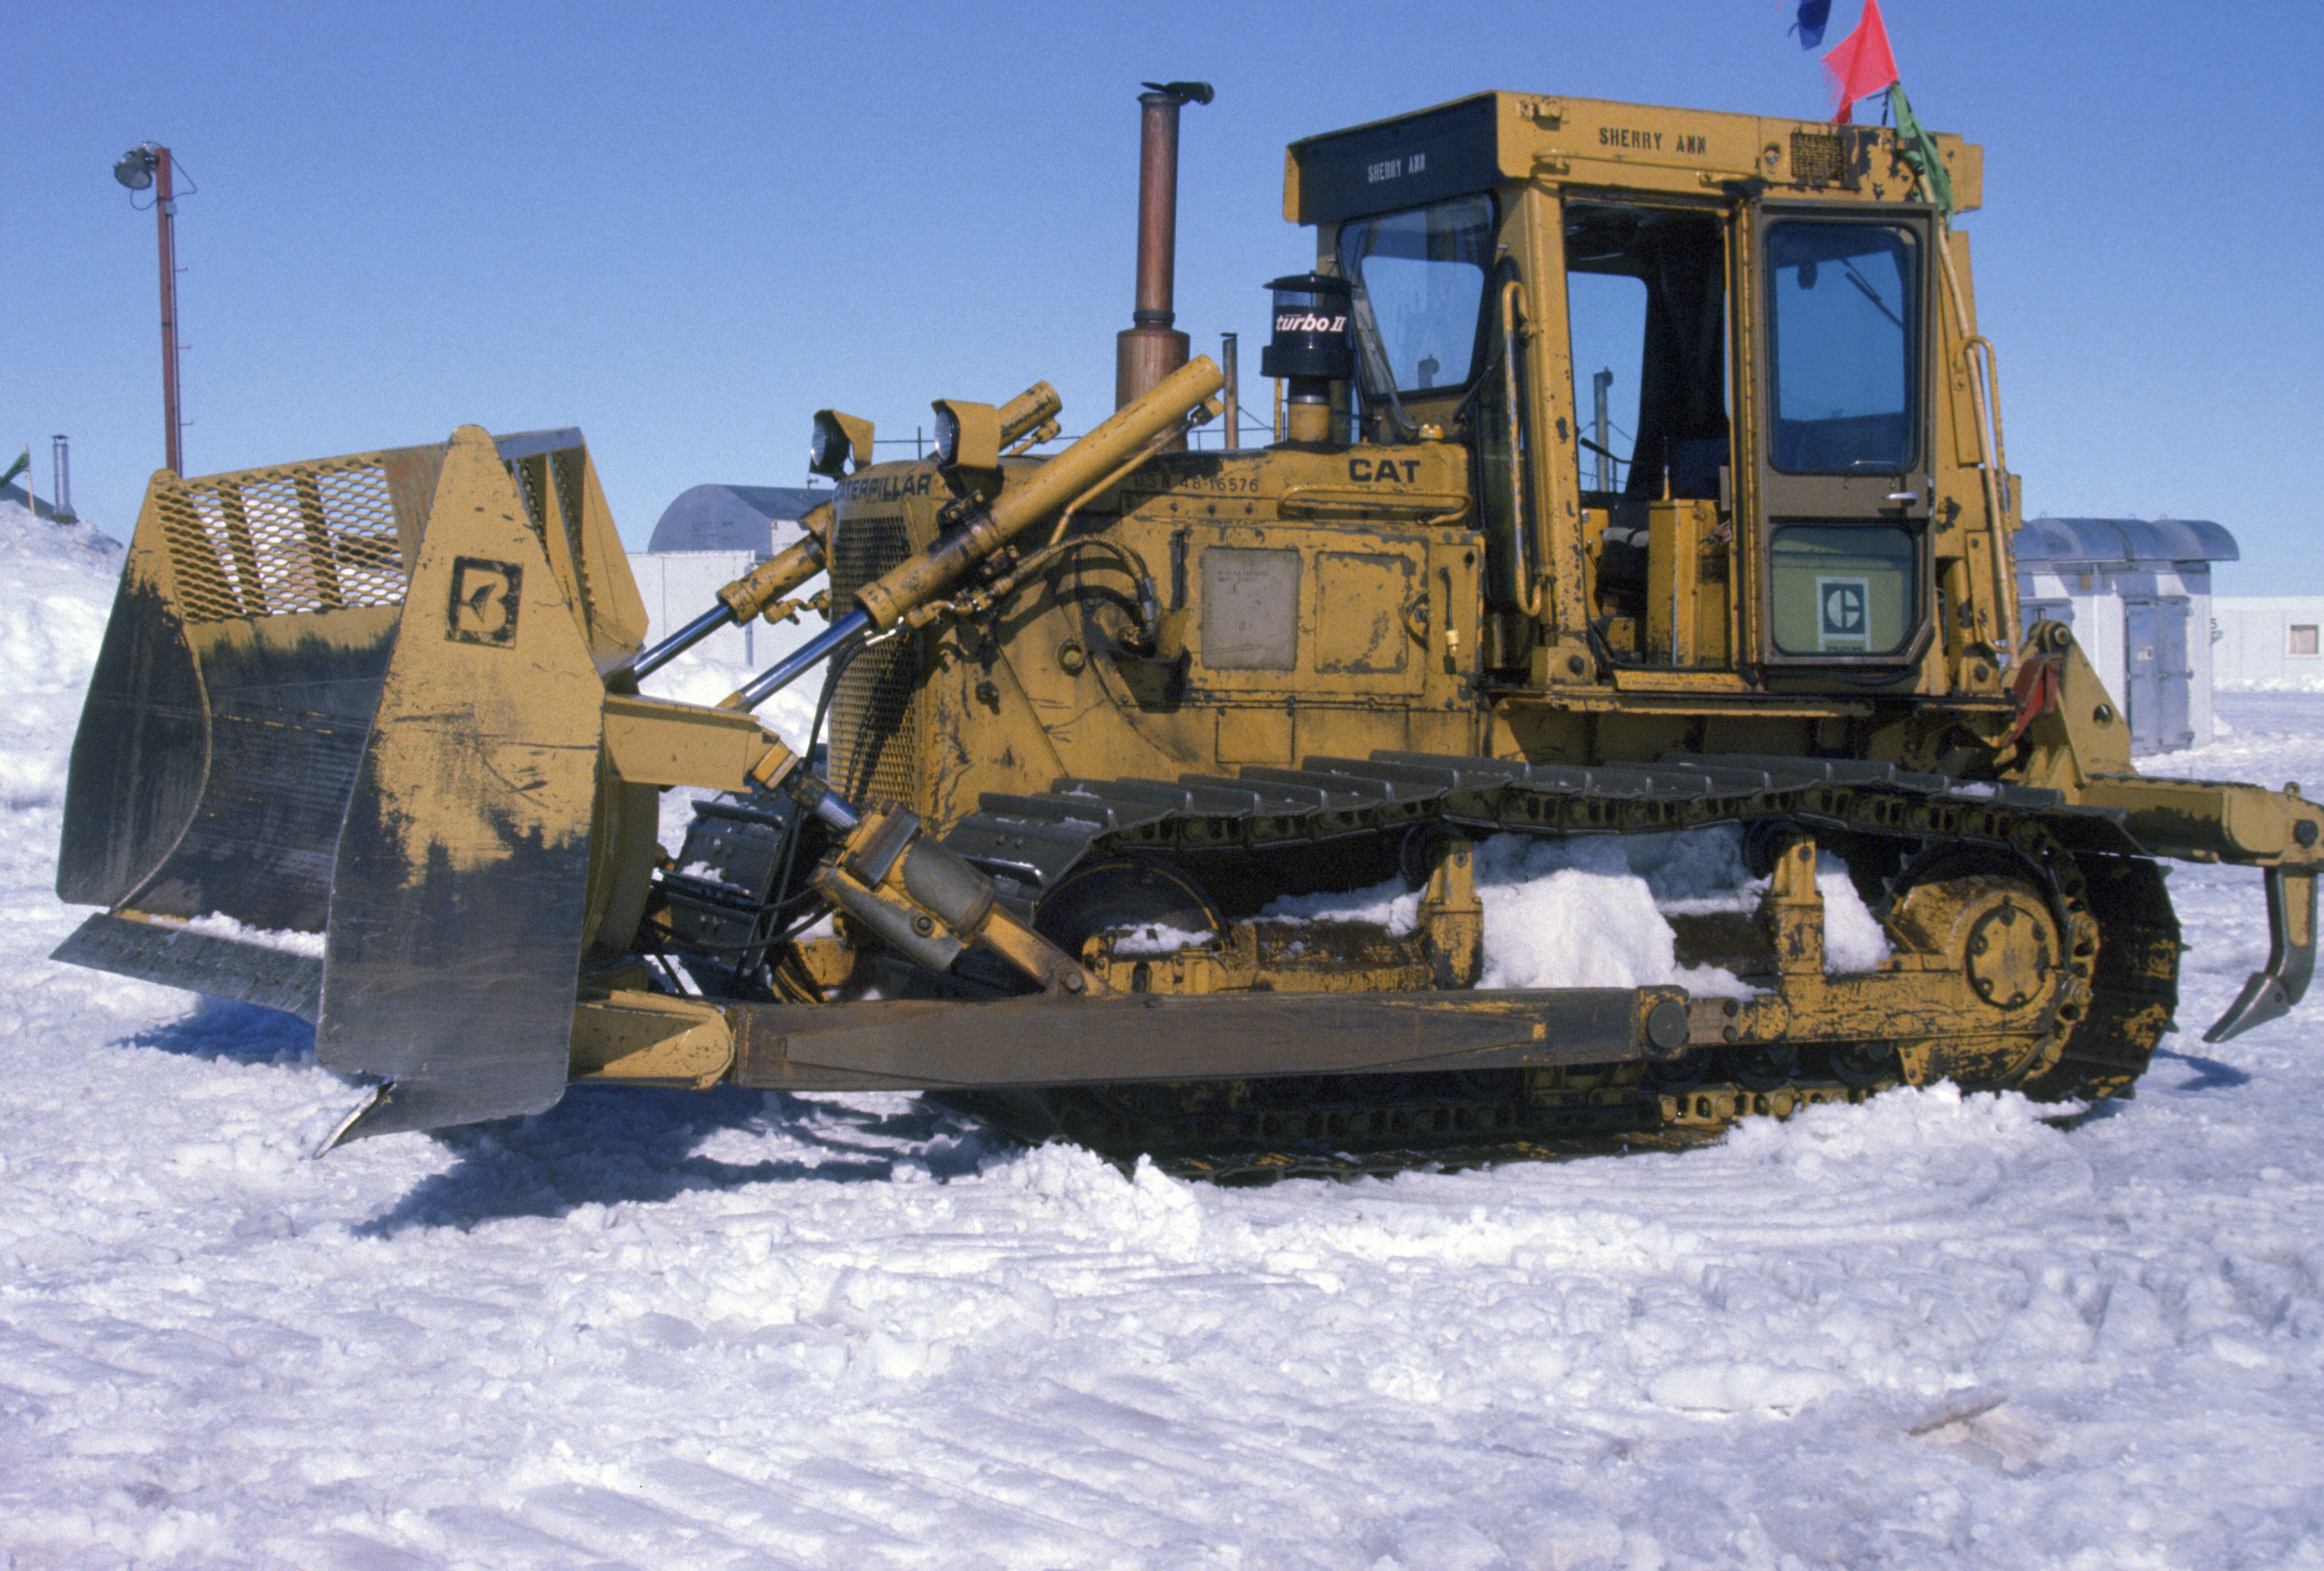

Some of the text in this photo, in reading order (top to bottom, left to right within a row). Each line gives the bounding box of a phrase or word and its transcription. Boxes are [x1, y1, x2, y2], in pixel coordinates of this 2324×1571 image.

[1599, 127, 1706, 154] SHERRY ANN
[1368, 153, 1425, 184] SHERRY ANN
[1276, 312, 1346, 332] turbo II
[1349, 459, 1421, 483] CAT
